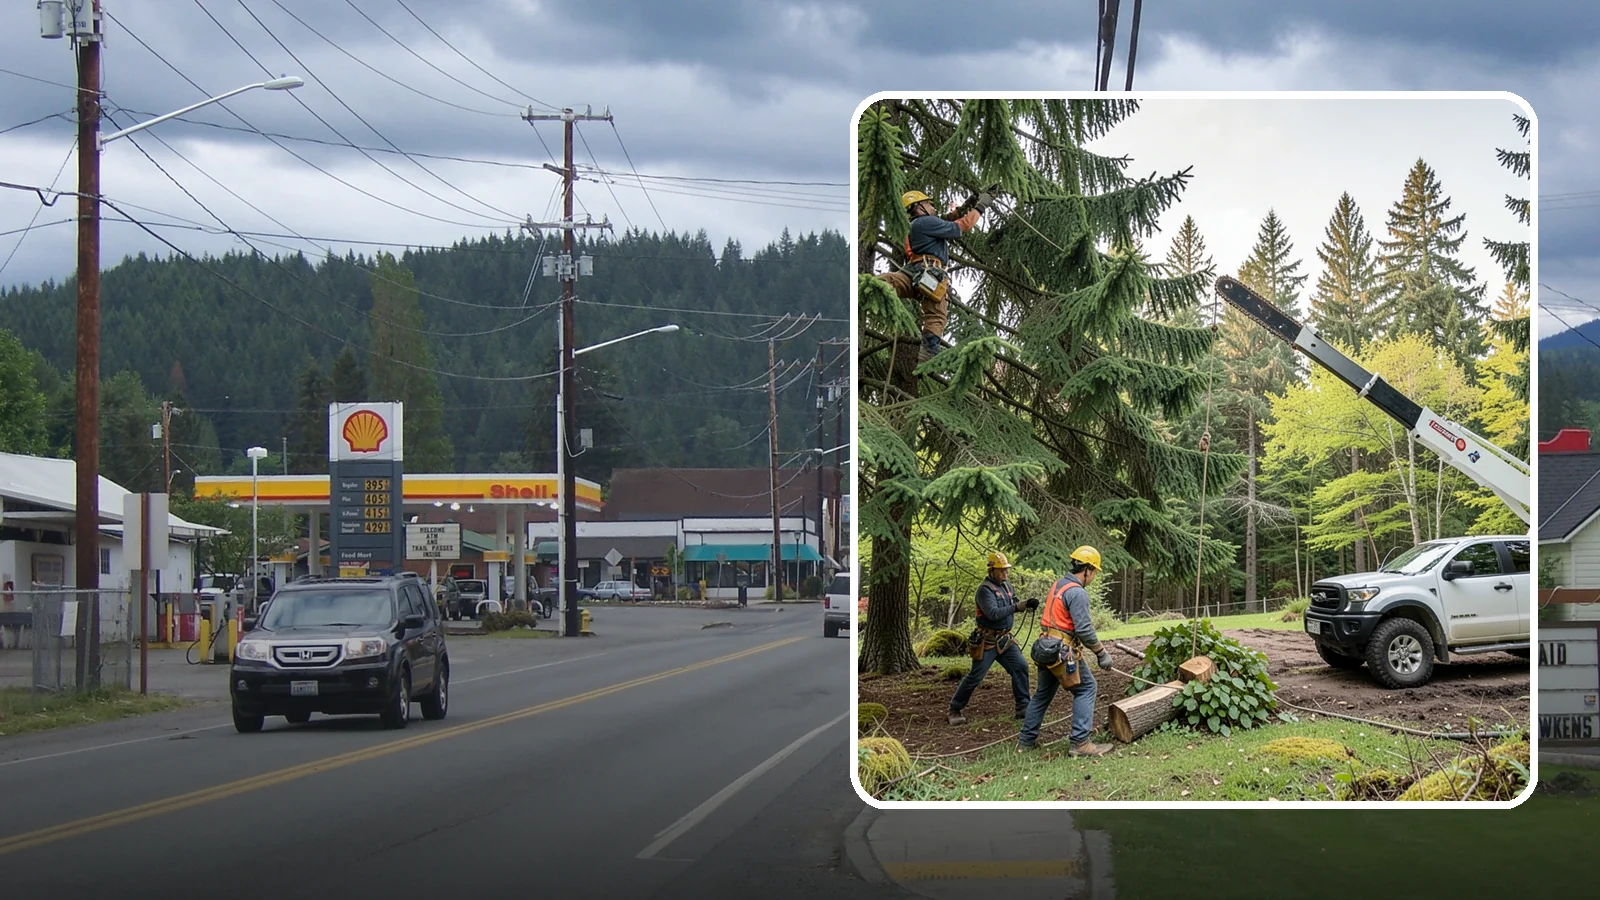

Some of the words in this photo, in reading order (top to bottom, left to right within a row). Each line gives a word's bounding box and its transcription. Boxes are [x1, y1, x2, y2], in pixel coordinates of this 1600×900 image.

[365, 480, 383, 490] 395
[490, 484, 547, 499] Shell
[365, 494, 383, 504] 405
[365, 508, 383, 518] 415
[366, 522, 383, 532] 429
[1538, 643, 1566, 665] AID
